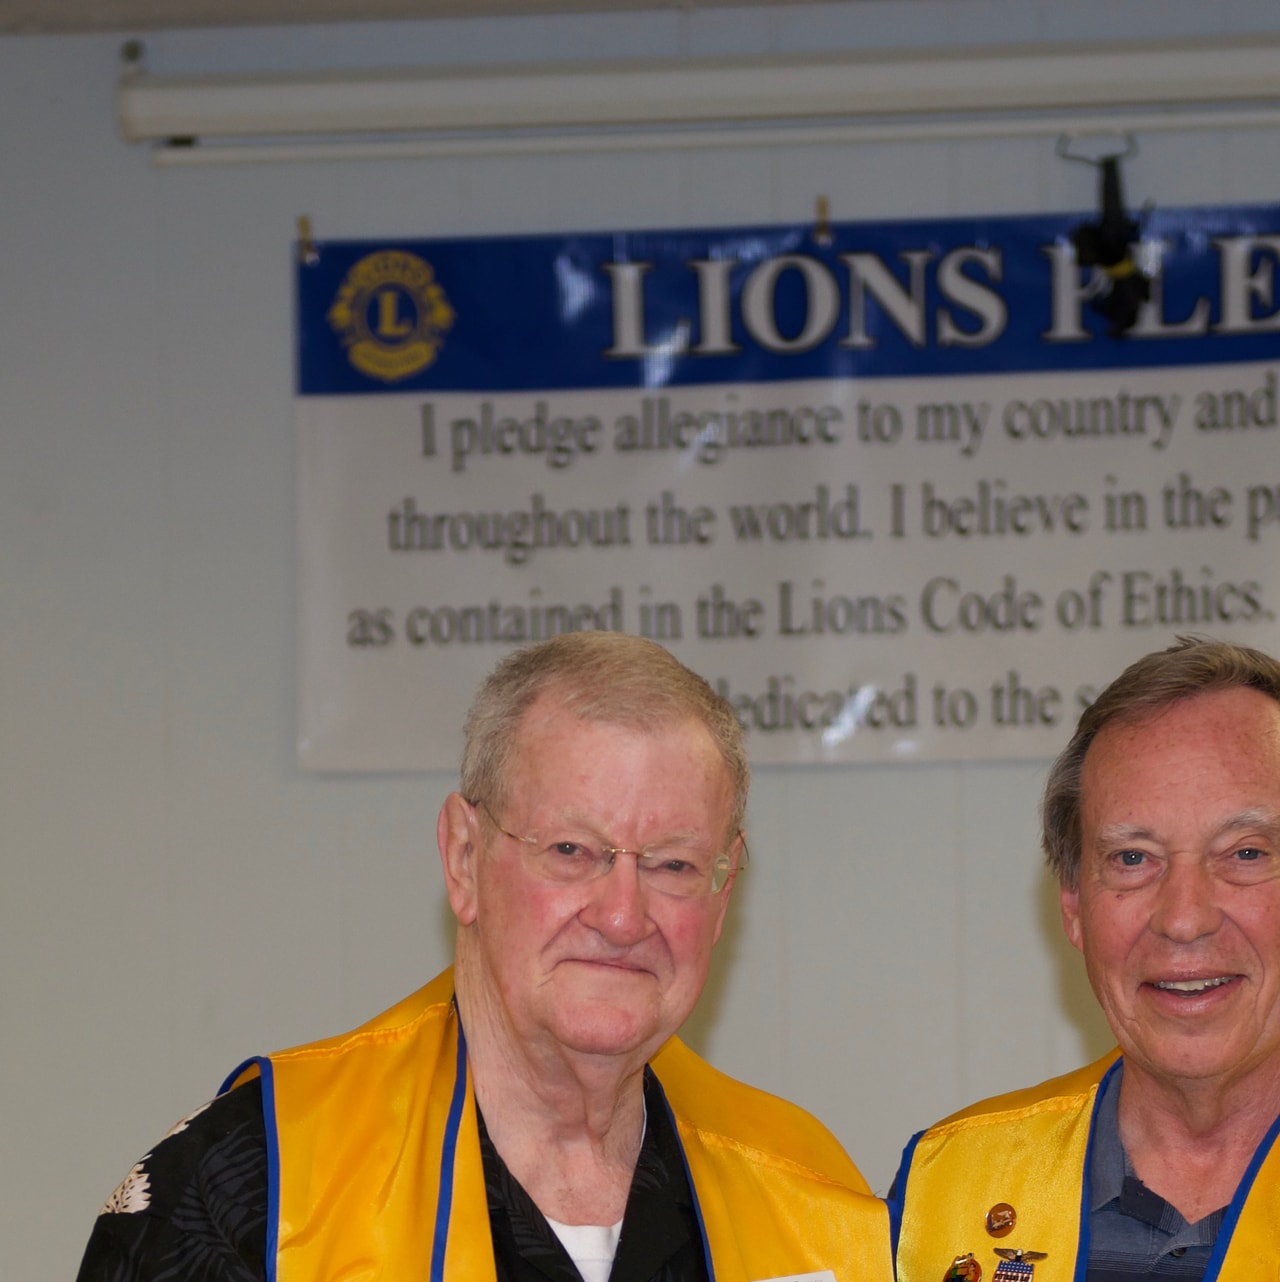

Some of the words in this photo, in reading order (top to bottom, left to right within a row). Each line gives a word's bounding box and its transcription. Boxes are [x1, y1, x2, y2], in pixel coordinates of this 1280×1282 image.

[604, 246, 1007, 360] LIONS
[420, 402, 437, 459] I
[451, 399, 598, 471] pledge
[614, 391, 843, 466] allegiance
[857, 389, 903, 444] to
[914, 402, 990, 460] my
[1002, 392, 1175, 450] country
[1195, 371, 1279, 431] and
[387, 494, 632, 564] throughout
[646, 491, 717, 547] the
[729, 485, 874, 541] world.
[889, 483, 908, 537] I
[920, 481, 1091, 539] believe
[1103, 474, 1149, 531] in
[1163, 470, 1232, 530] the
[347, 610, 395, 649] as
[406, 590, 625, 646] contained
[639, 585, 683, 642] in
[696, 585, 764, 640] the
[777, 579, 909, 638] Lions
[919, 574, 1044, 633] Code
[1056, 570, 1114, 632] of
[1120, 567, 1276, 628] Ethics.
[717, 673, 917, 731] edicated
[932, 682, 979, 728] to
[991, 671, 1062, 726] the
